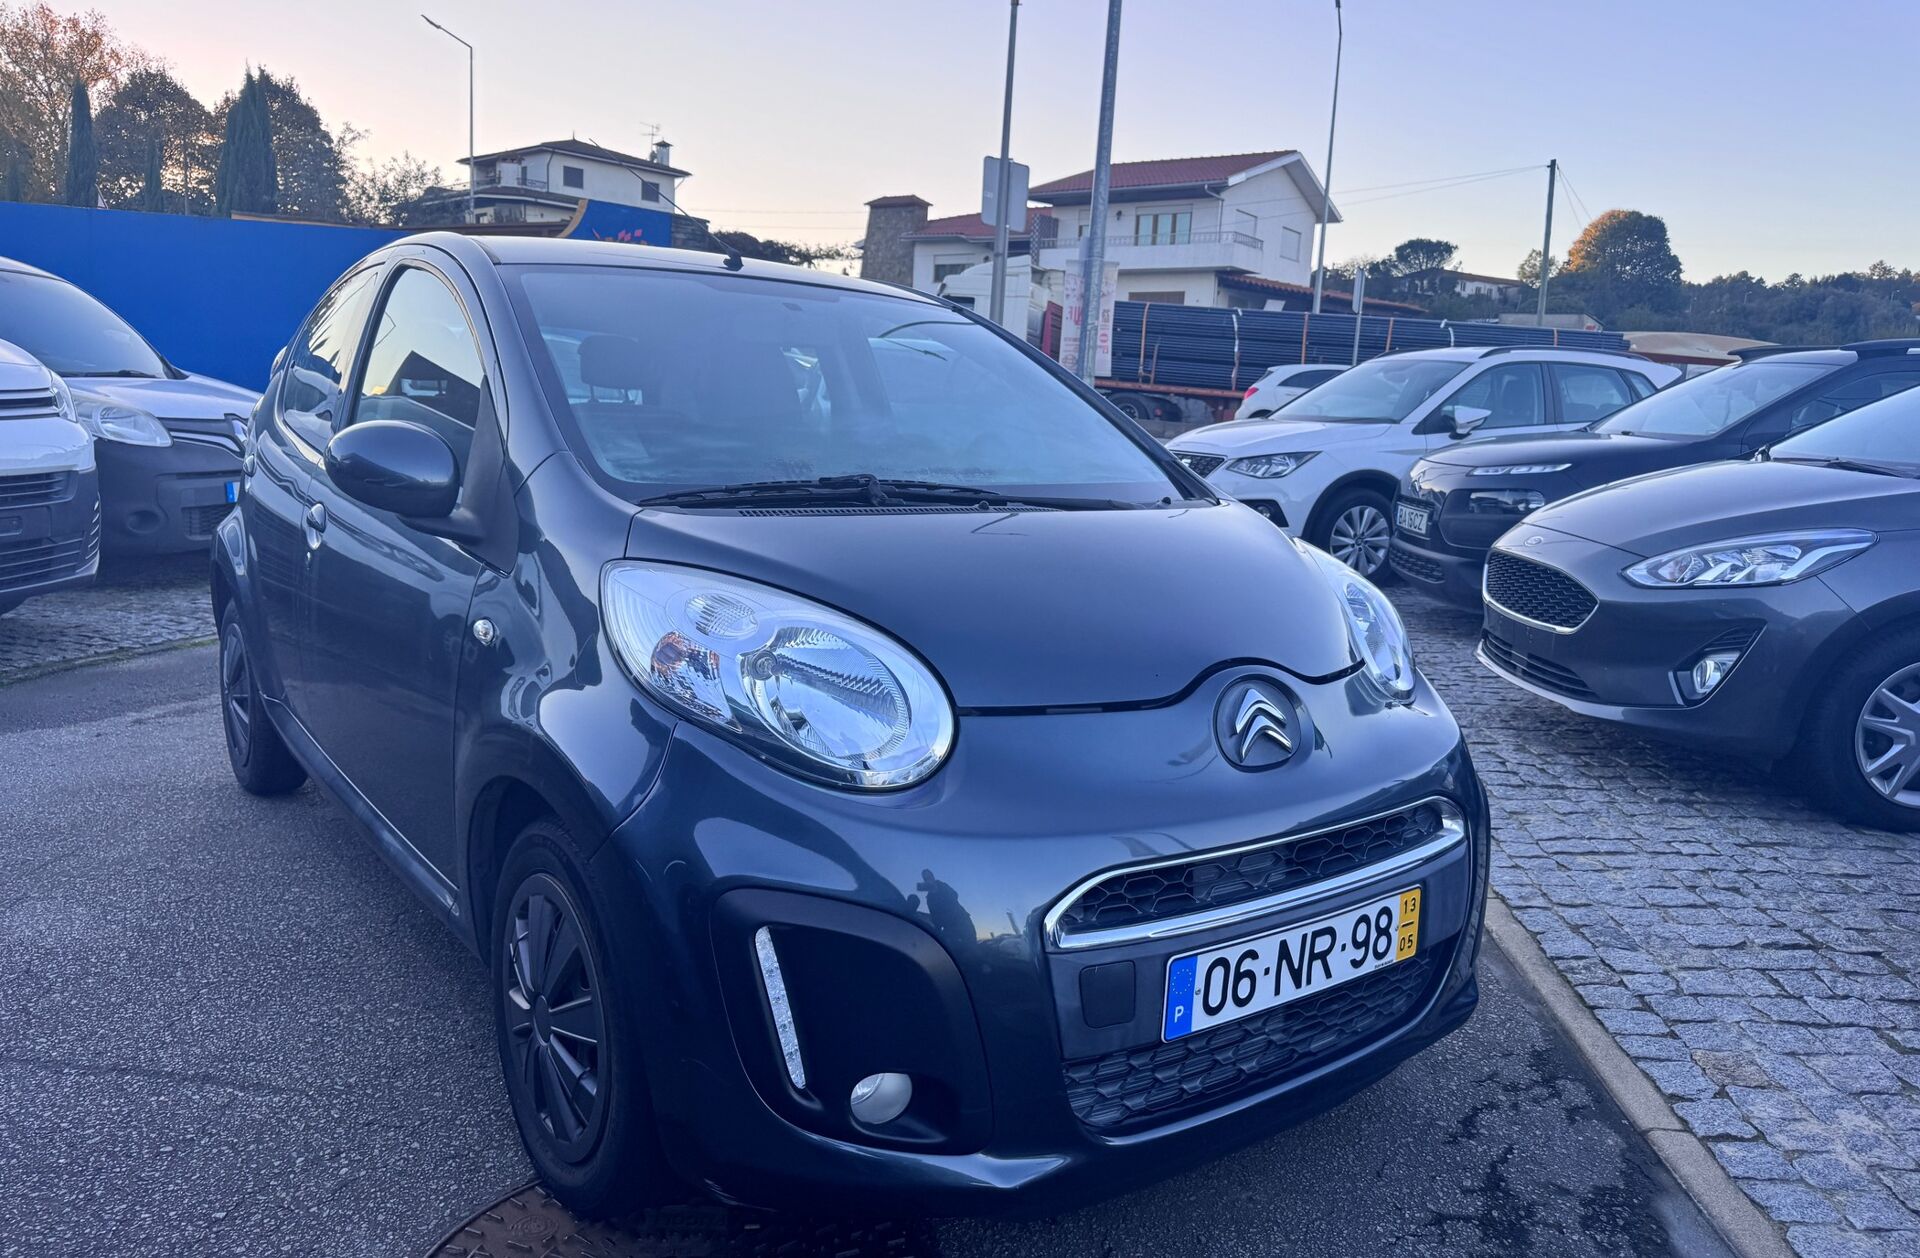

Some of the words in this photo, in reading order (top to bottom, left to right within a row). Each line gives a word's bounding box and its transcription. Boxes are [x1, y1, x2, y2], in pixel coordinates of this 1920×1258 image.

[1404, 897, 1416, 914] 13
[1399, 934, 1413, 951] 05
[1174, 1005, 1184, 1023] P
